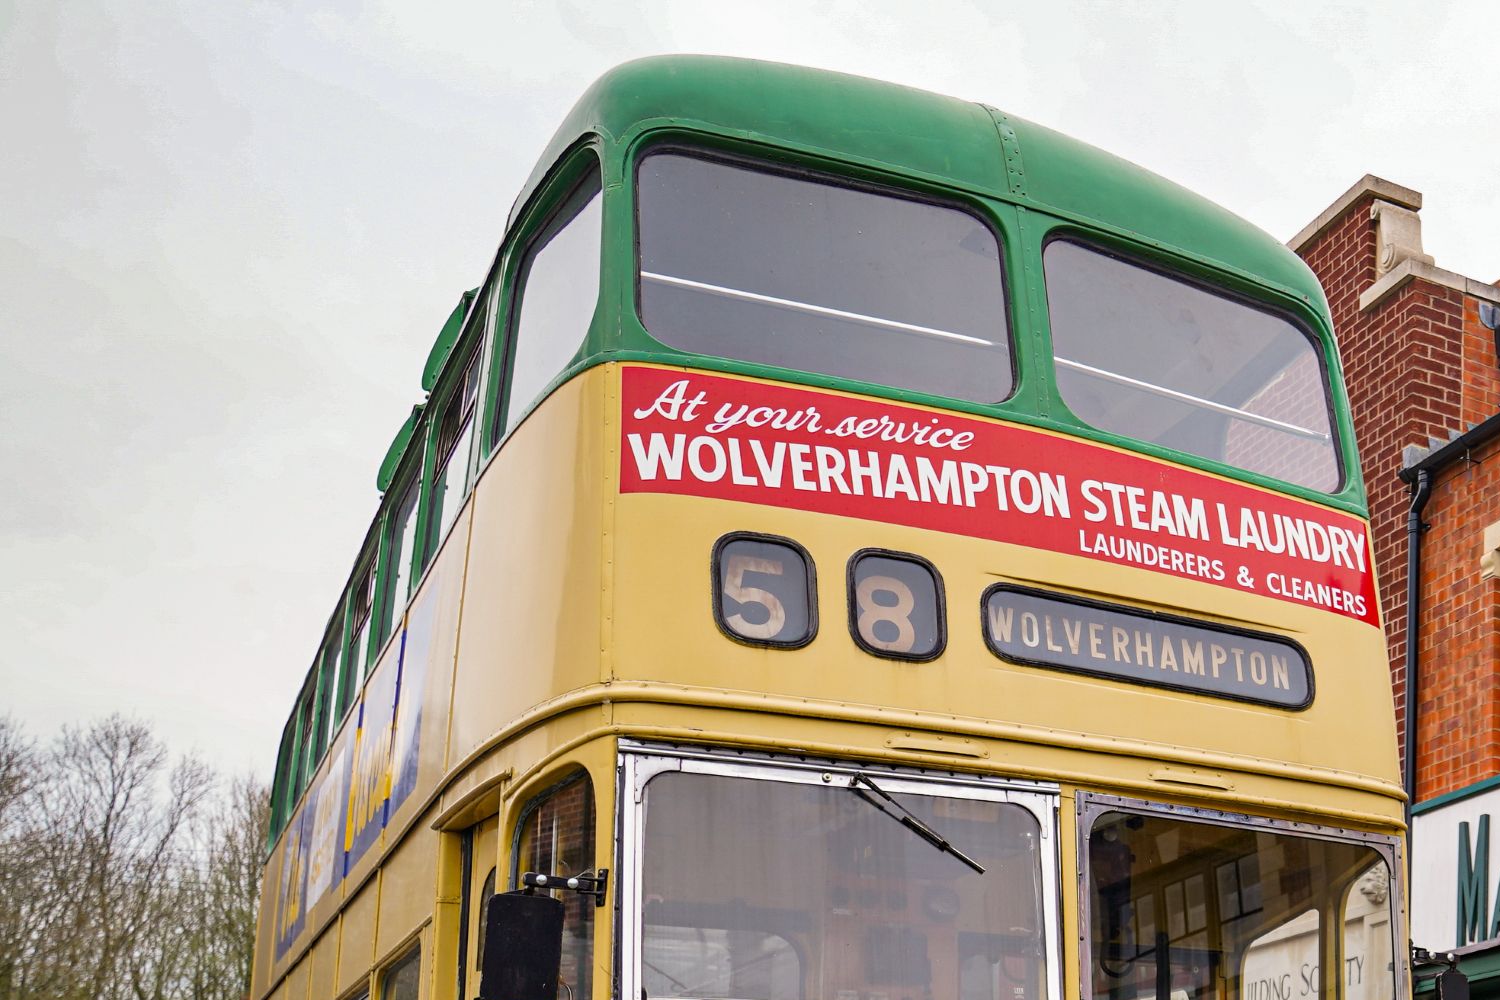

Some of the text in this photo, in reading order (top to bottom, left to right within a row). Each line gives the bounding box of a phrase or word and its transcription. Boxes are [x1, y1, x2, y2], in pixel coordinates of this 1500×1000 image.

[633, 380, 976, 451] At your service
[627, 432, 1367, 573] WOLVERHAMPTON STEAM LAUNDRY
[723, 555, 916, 653] 5 8
[1079, 529, 1367, 617] LAUNDERERS & CLEANERS
[990, 605, 1291, 692] WOLVERHAMPTON
